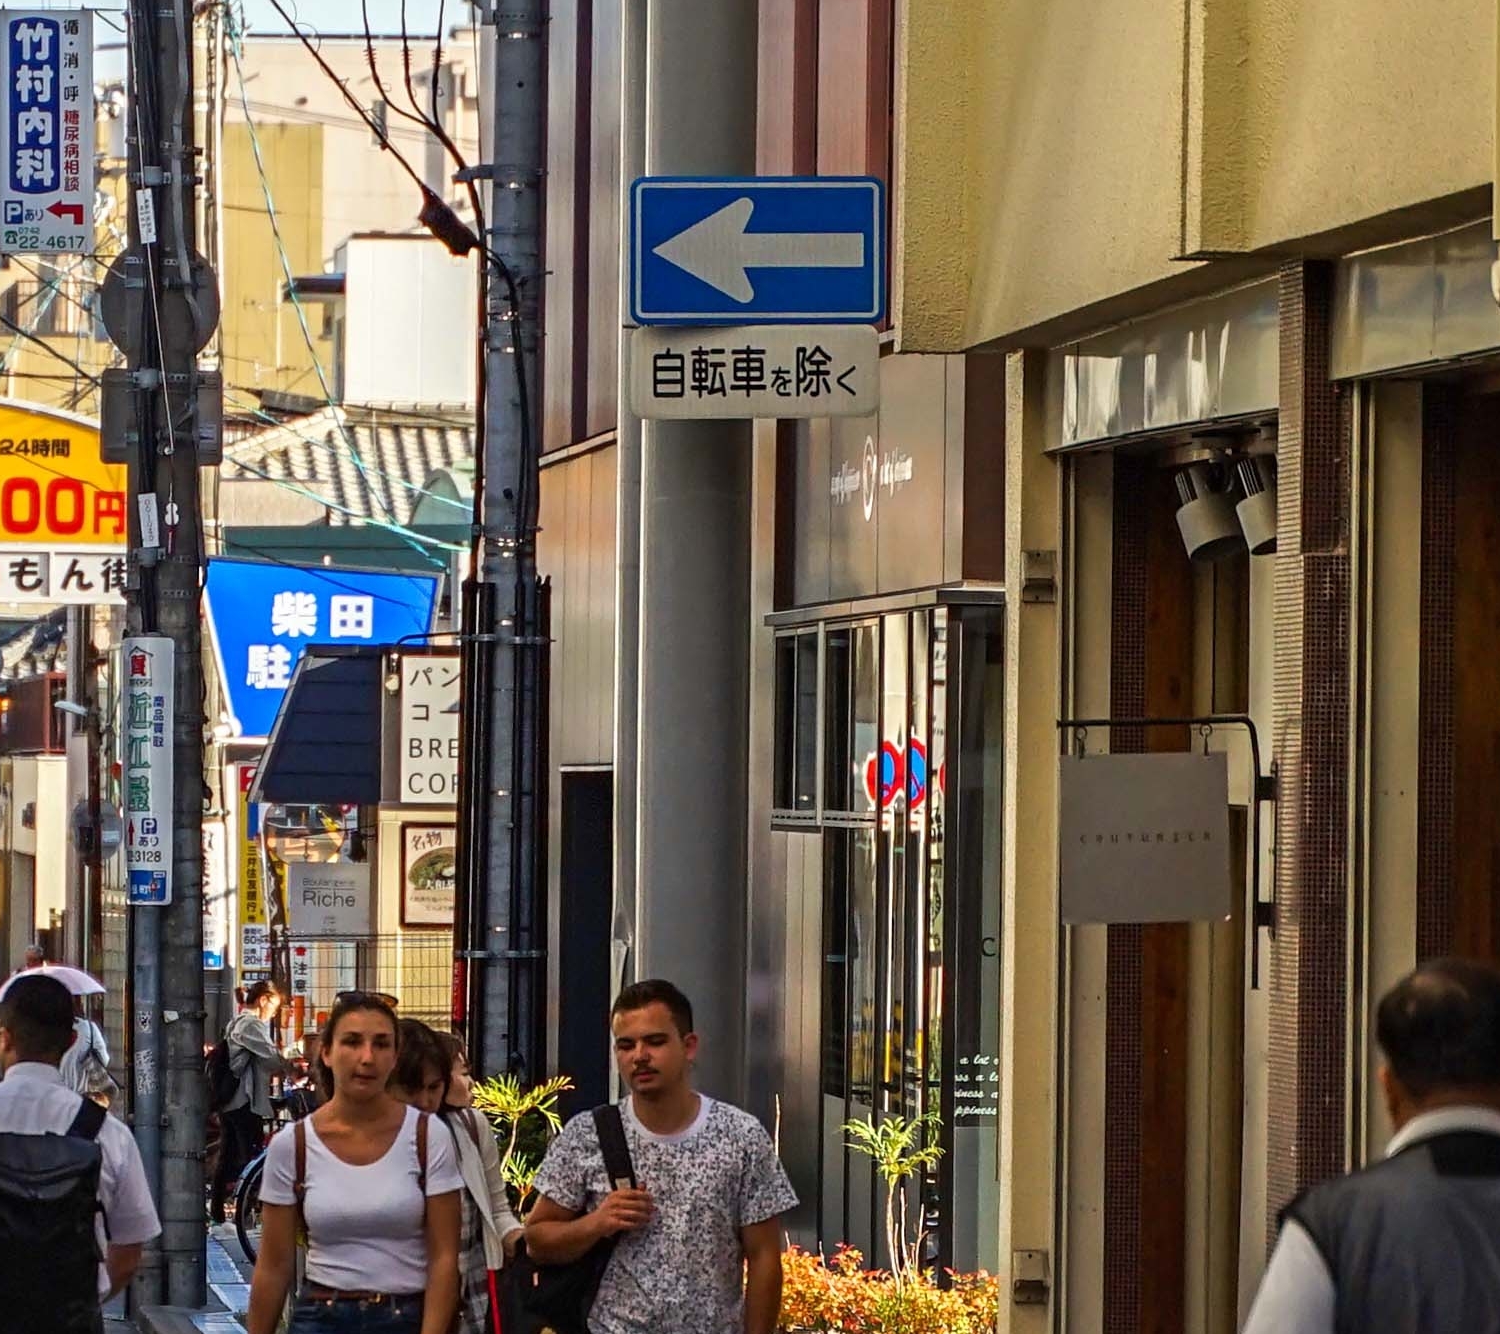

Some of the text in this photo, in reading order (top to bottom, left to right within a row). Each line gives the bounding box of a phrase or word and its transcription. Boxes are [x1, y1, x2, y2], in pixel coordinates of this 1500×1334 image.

[15, 22, 55, 187] 竹村内科
[64, 110, 80, 193] 糖尿病相談
[24, 208, 44, 222] あり
[18, 227, 41, 235] 0742
[19, 235, 86, 249] 22-4617
[653, 346, 857, 398] 自転車を除く
[0, 439, 70, 458] 24時間
[271, 591, 374, 638] 柴田
[410, 666, 460, 688] パン
[128, 692, 152, 812] 近江屋
[138, 836, 159, 847] あり
[302, 890, 356, 907] Riche
